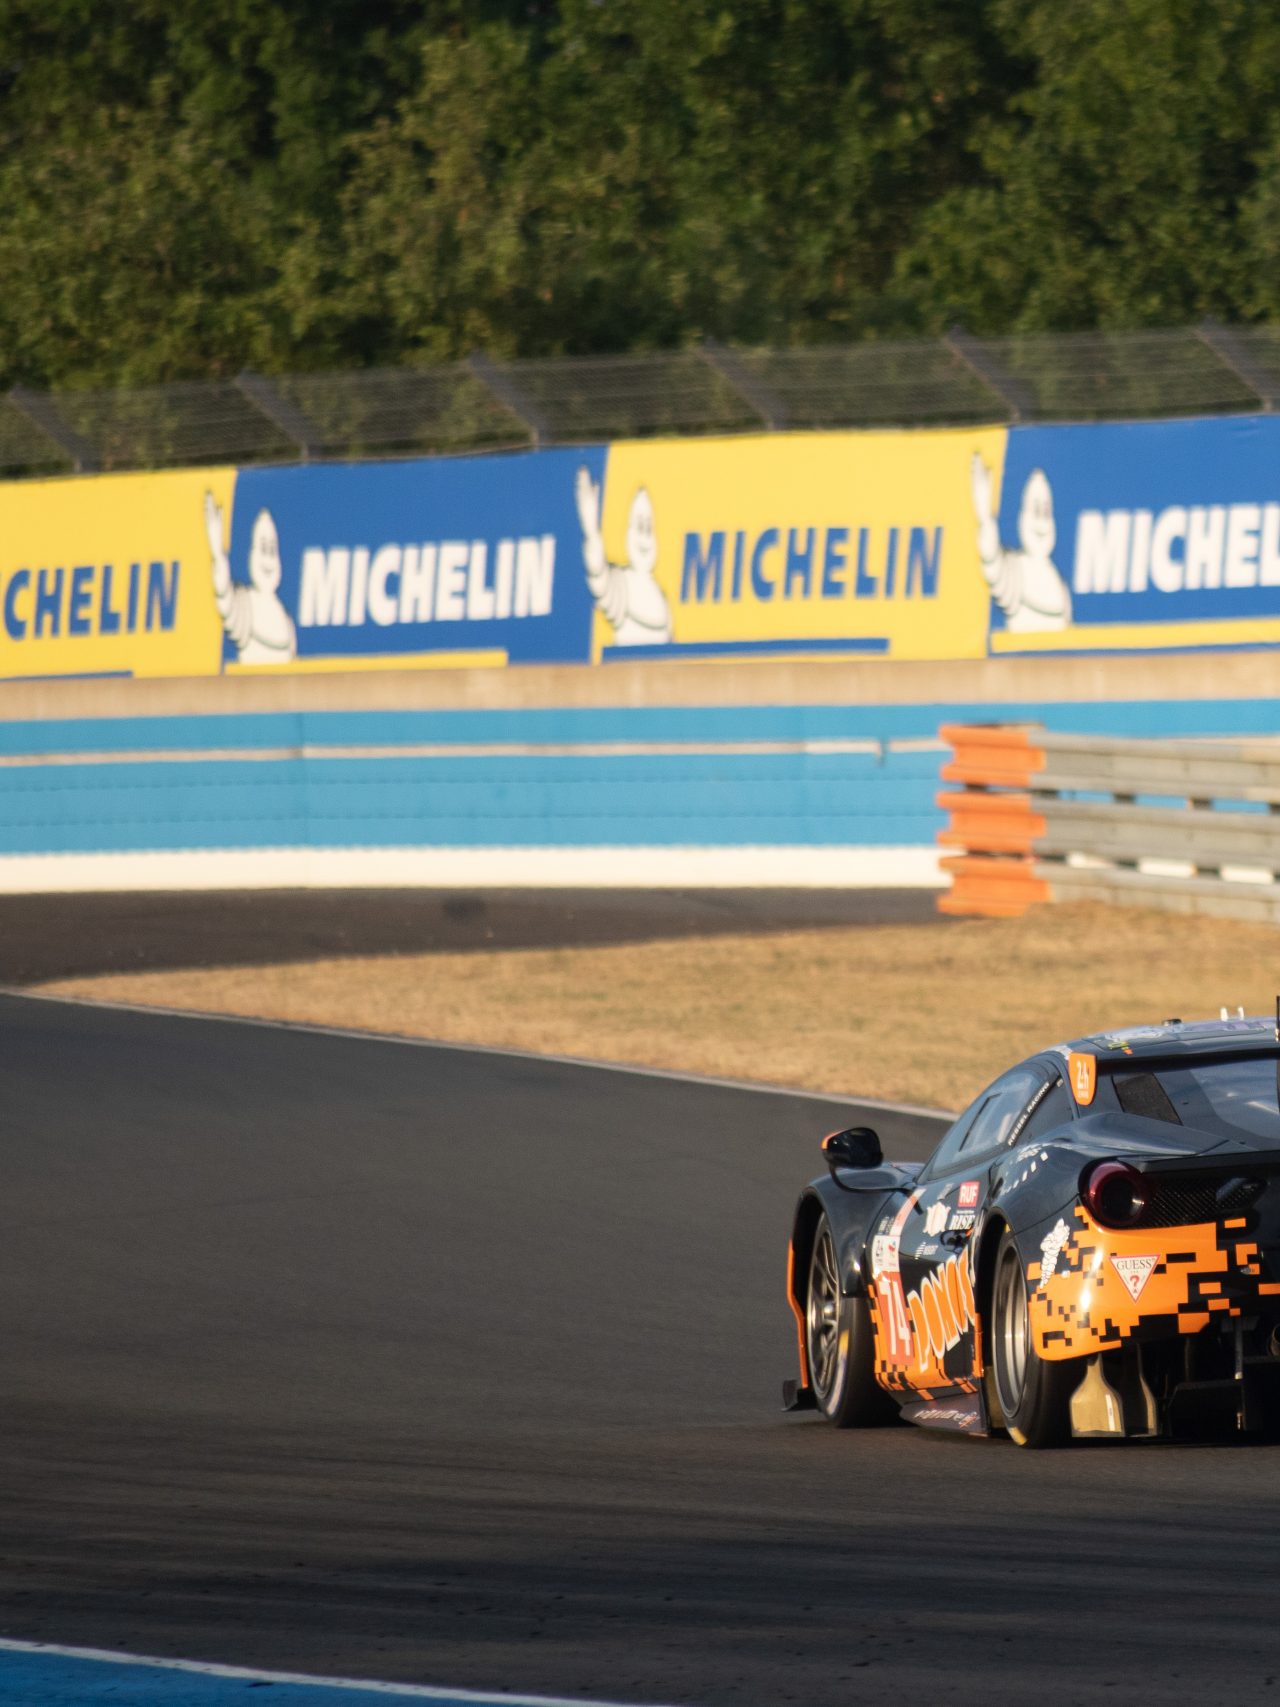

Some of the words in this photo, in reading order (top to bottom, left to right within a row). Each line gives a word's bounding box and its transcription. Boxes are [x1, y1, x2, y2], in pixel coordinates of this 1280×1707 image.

[302, 536, 555, 626] MICHELIN
[681, 528, 941, 601] MICHELIN
[959, 1185, 979, 1204] RUF
[1116, 1258, 1152, 1271] GUESS
[878, 1277, 911, 1356] 74
